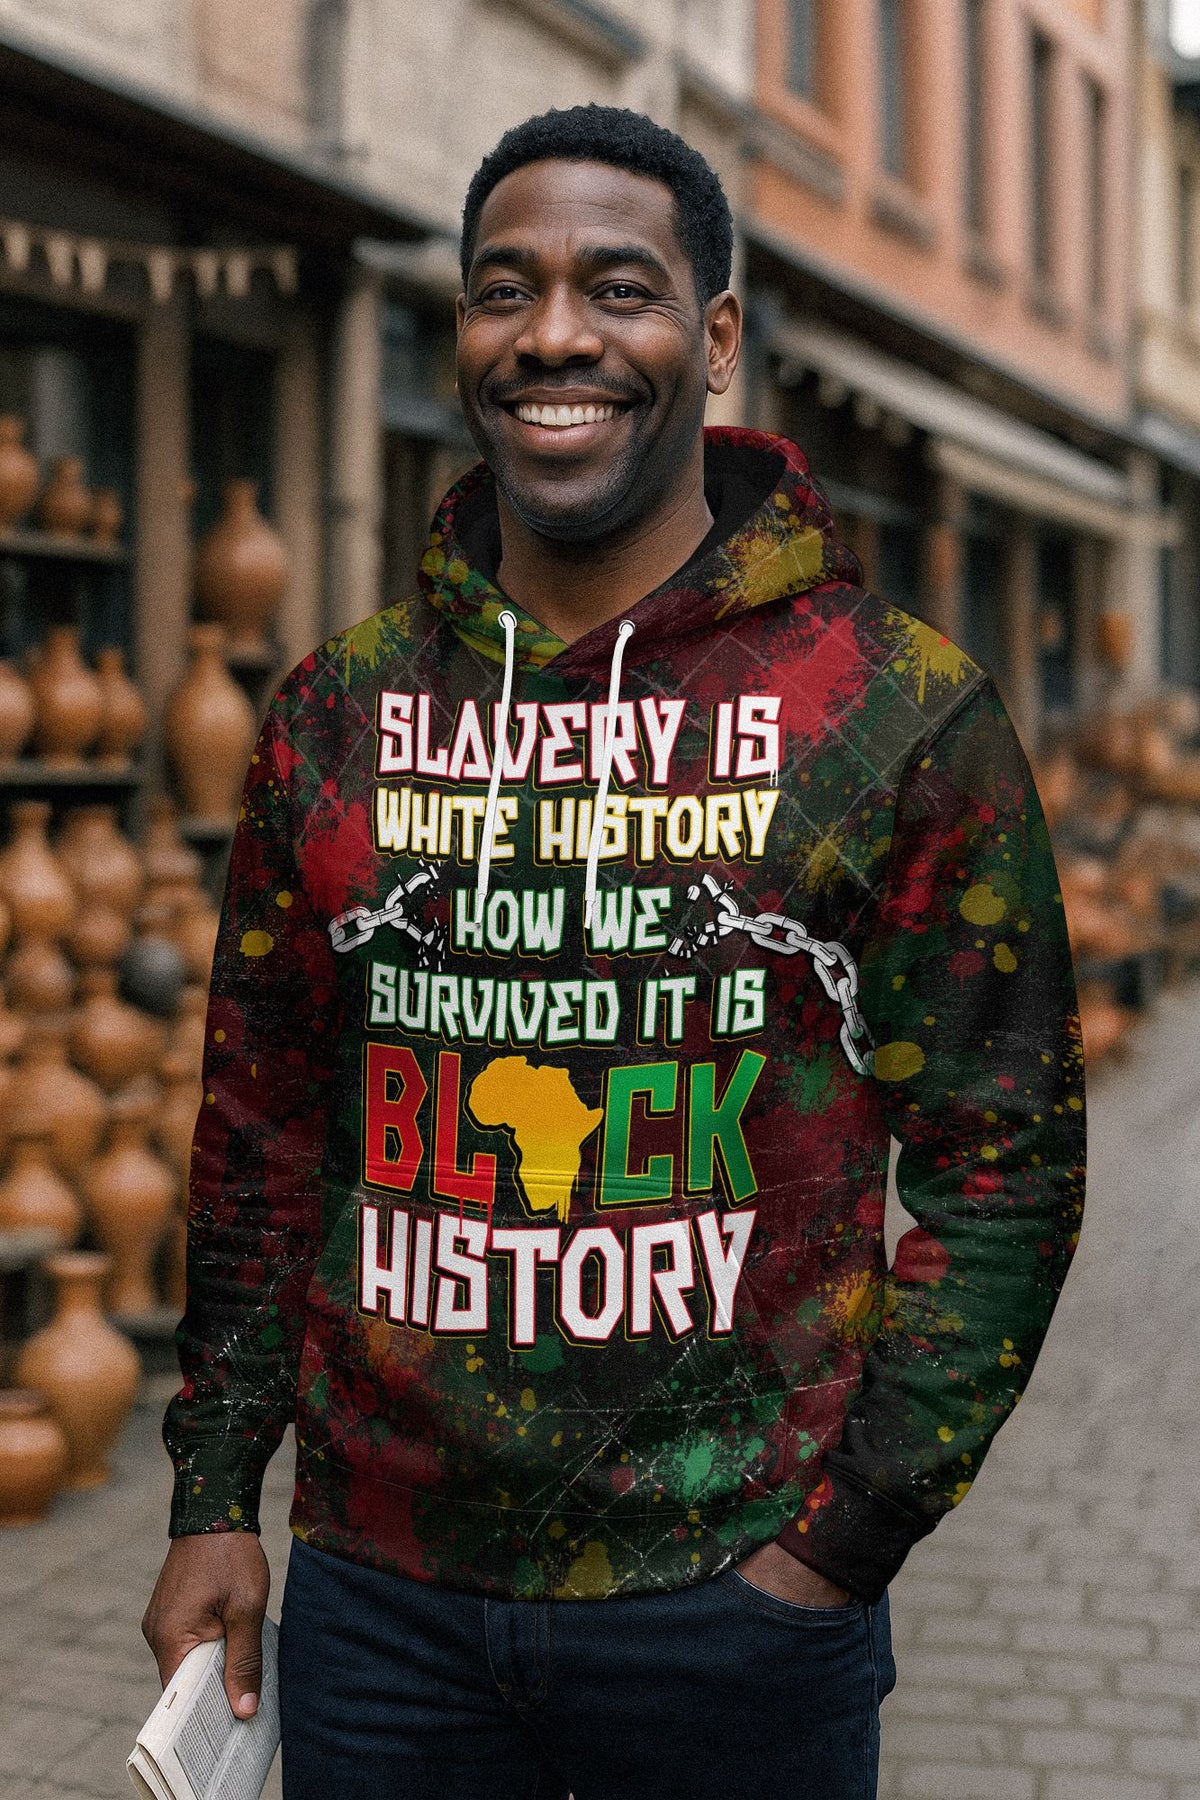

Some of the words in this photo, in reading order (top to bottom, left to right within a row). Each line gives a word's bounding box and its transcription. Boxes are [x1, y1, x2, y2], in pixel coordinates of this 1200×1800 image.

[379, 692, 686, 784] SLAVERY
[715, 695, 782, 778] IS
[377, 788, 518, 860] WHITE
[538, 789, 780, 862] HISTORY
[454, 887, 566, 952] HOW
[589, 885, 672, 952] WE
[369, 962, 621, 1044] SURVIVED
[642, 972, 695, 1041] IT
[716, 969, 767, 1033] IS
[364, 1041, 766, 1214] BLCK
[360, 1205, 758, 1344] HISTORY
